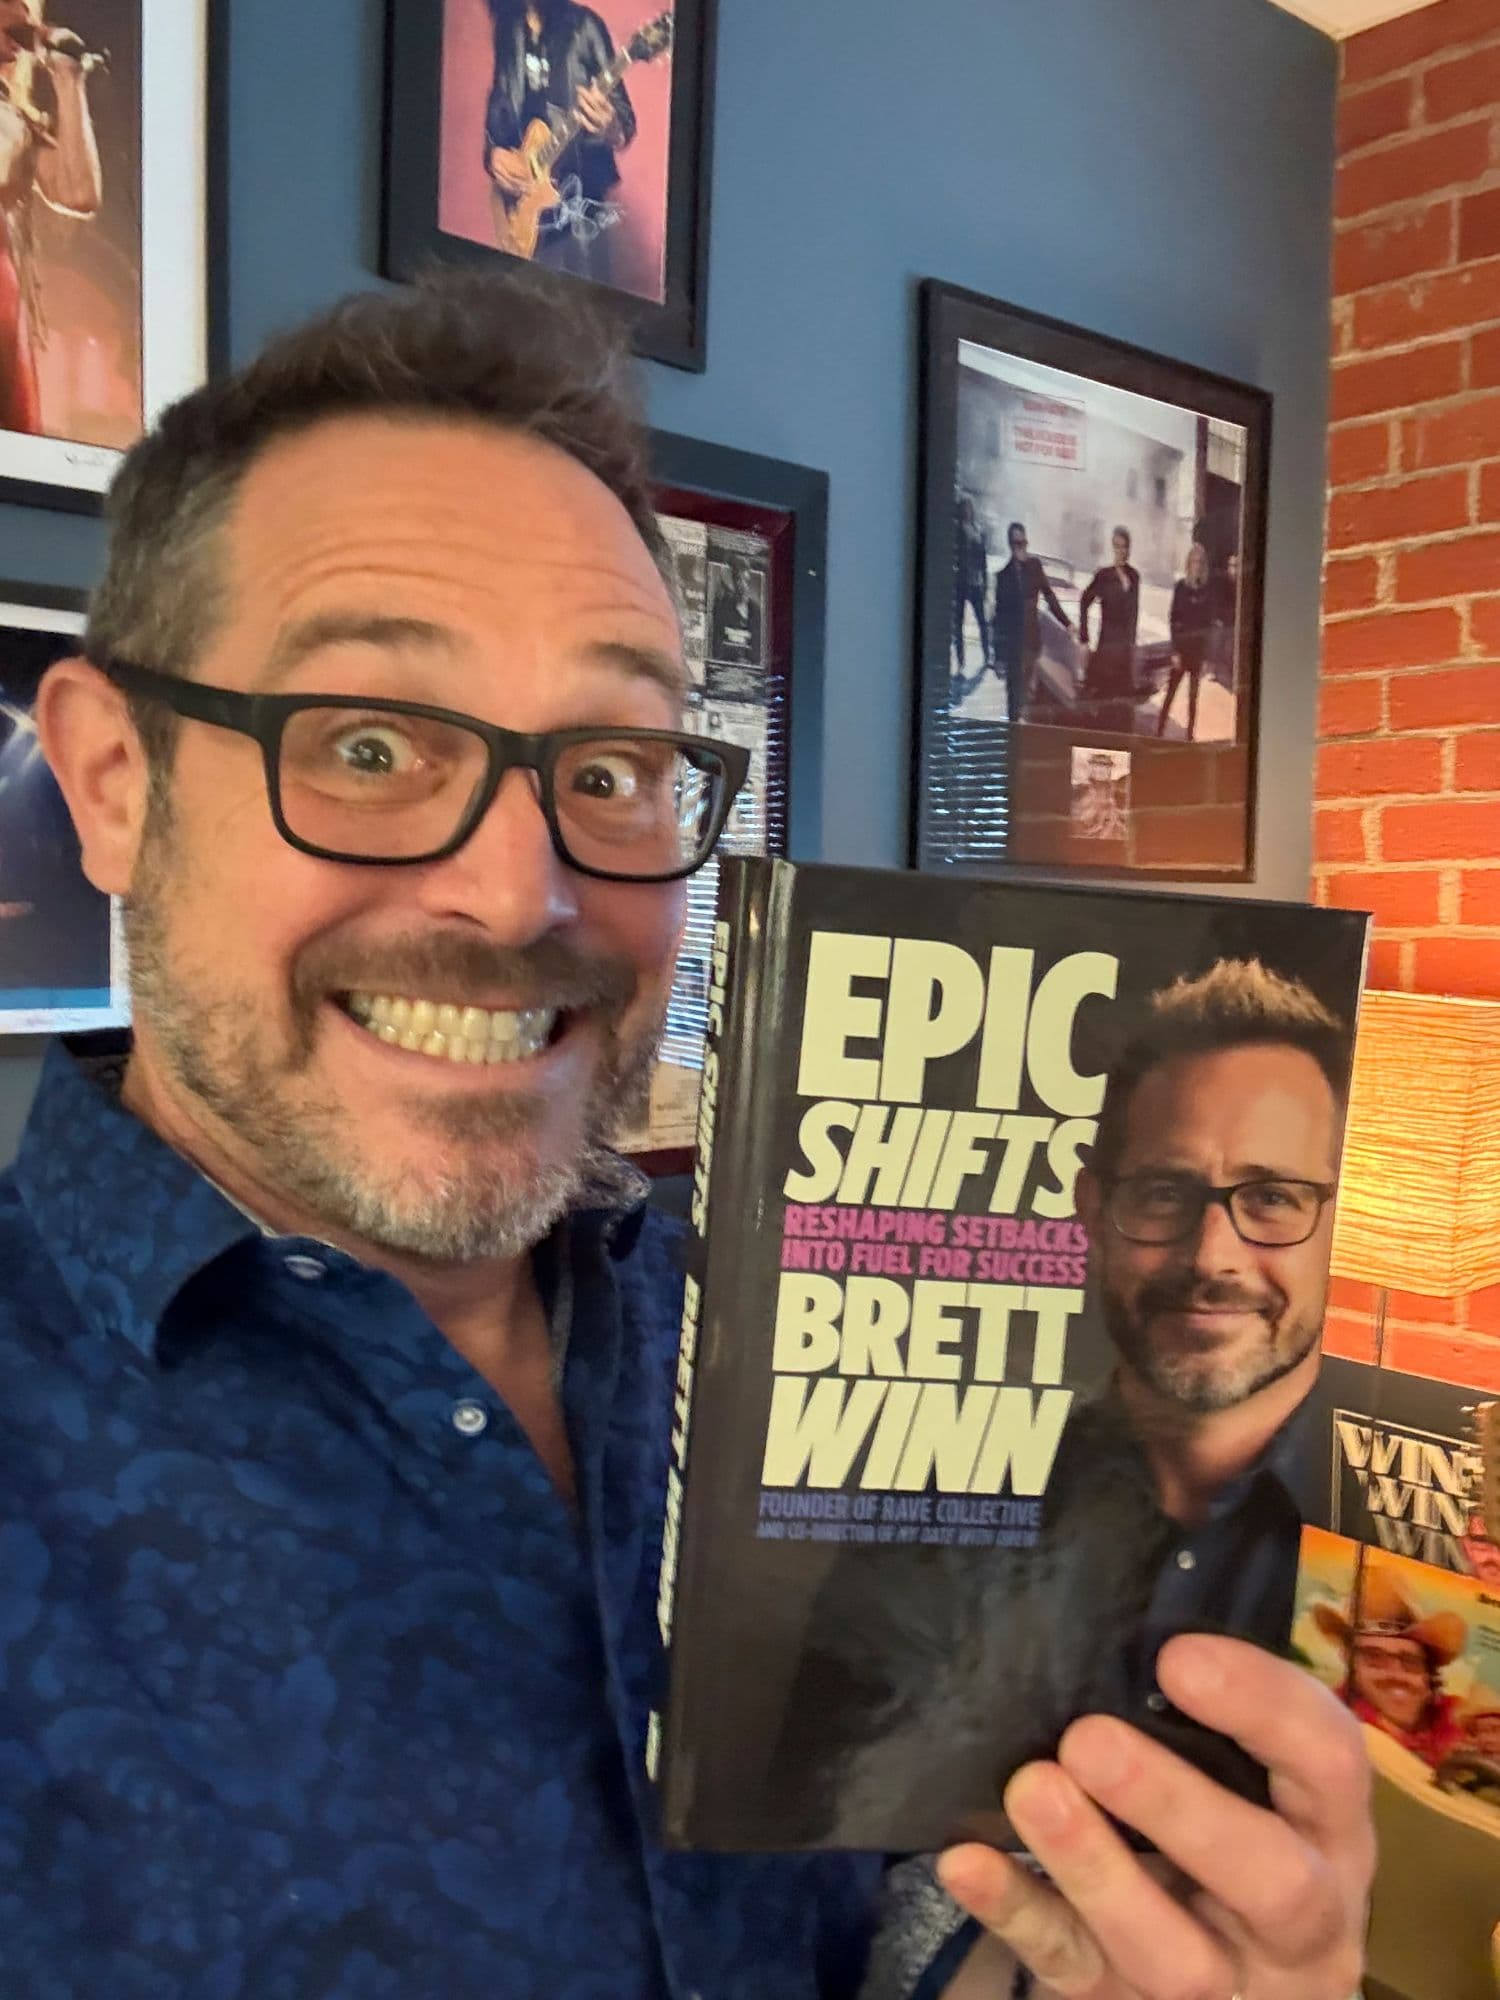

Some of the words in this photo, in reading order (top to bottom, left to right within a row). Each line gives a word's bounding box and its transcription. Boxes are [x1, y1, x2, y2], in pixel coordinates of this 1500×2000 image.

[797, 931, 1120, 1117] EPIC
[783, 1100, 1100, 1218] SHIFTS
[780, 1238, 846, 1271] INTO
[852, 1242, 912, 1275] FUEL
[918, 1246, 973, 1279] FOR
[976, 1250, 1088, 1285] SUCCESS
[783, 1204, 947, 1244] RESHAPING
[951, 1214, 1089, 1252] SETBACKS
[772, 1271, 1086, 1385] BRETT
[761, 1375, 1075, 1497] WINN
[759, 1491, 848, 1520] FOUNDER
[853, 1494, 879, 1521] OF
[935, 1498, 1041, 1527] COLLECTIVE
